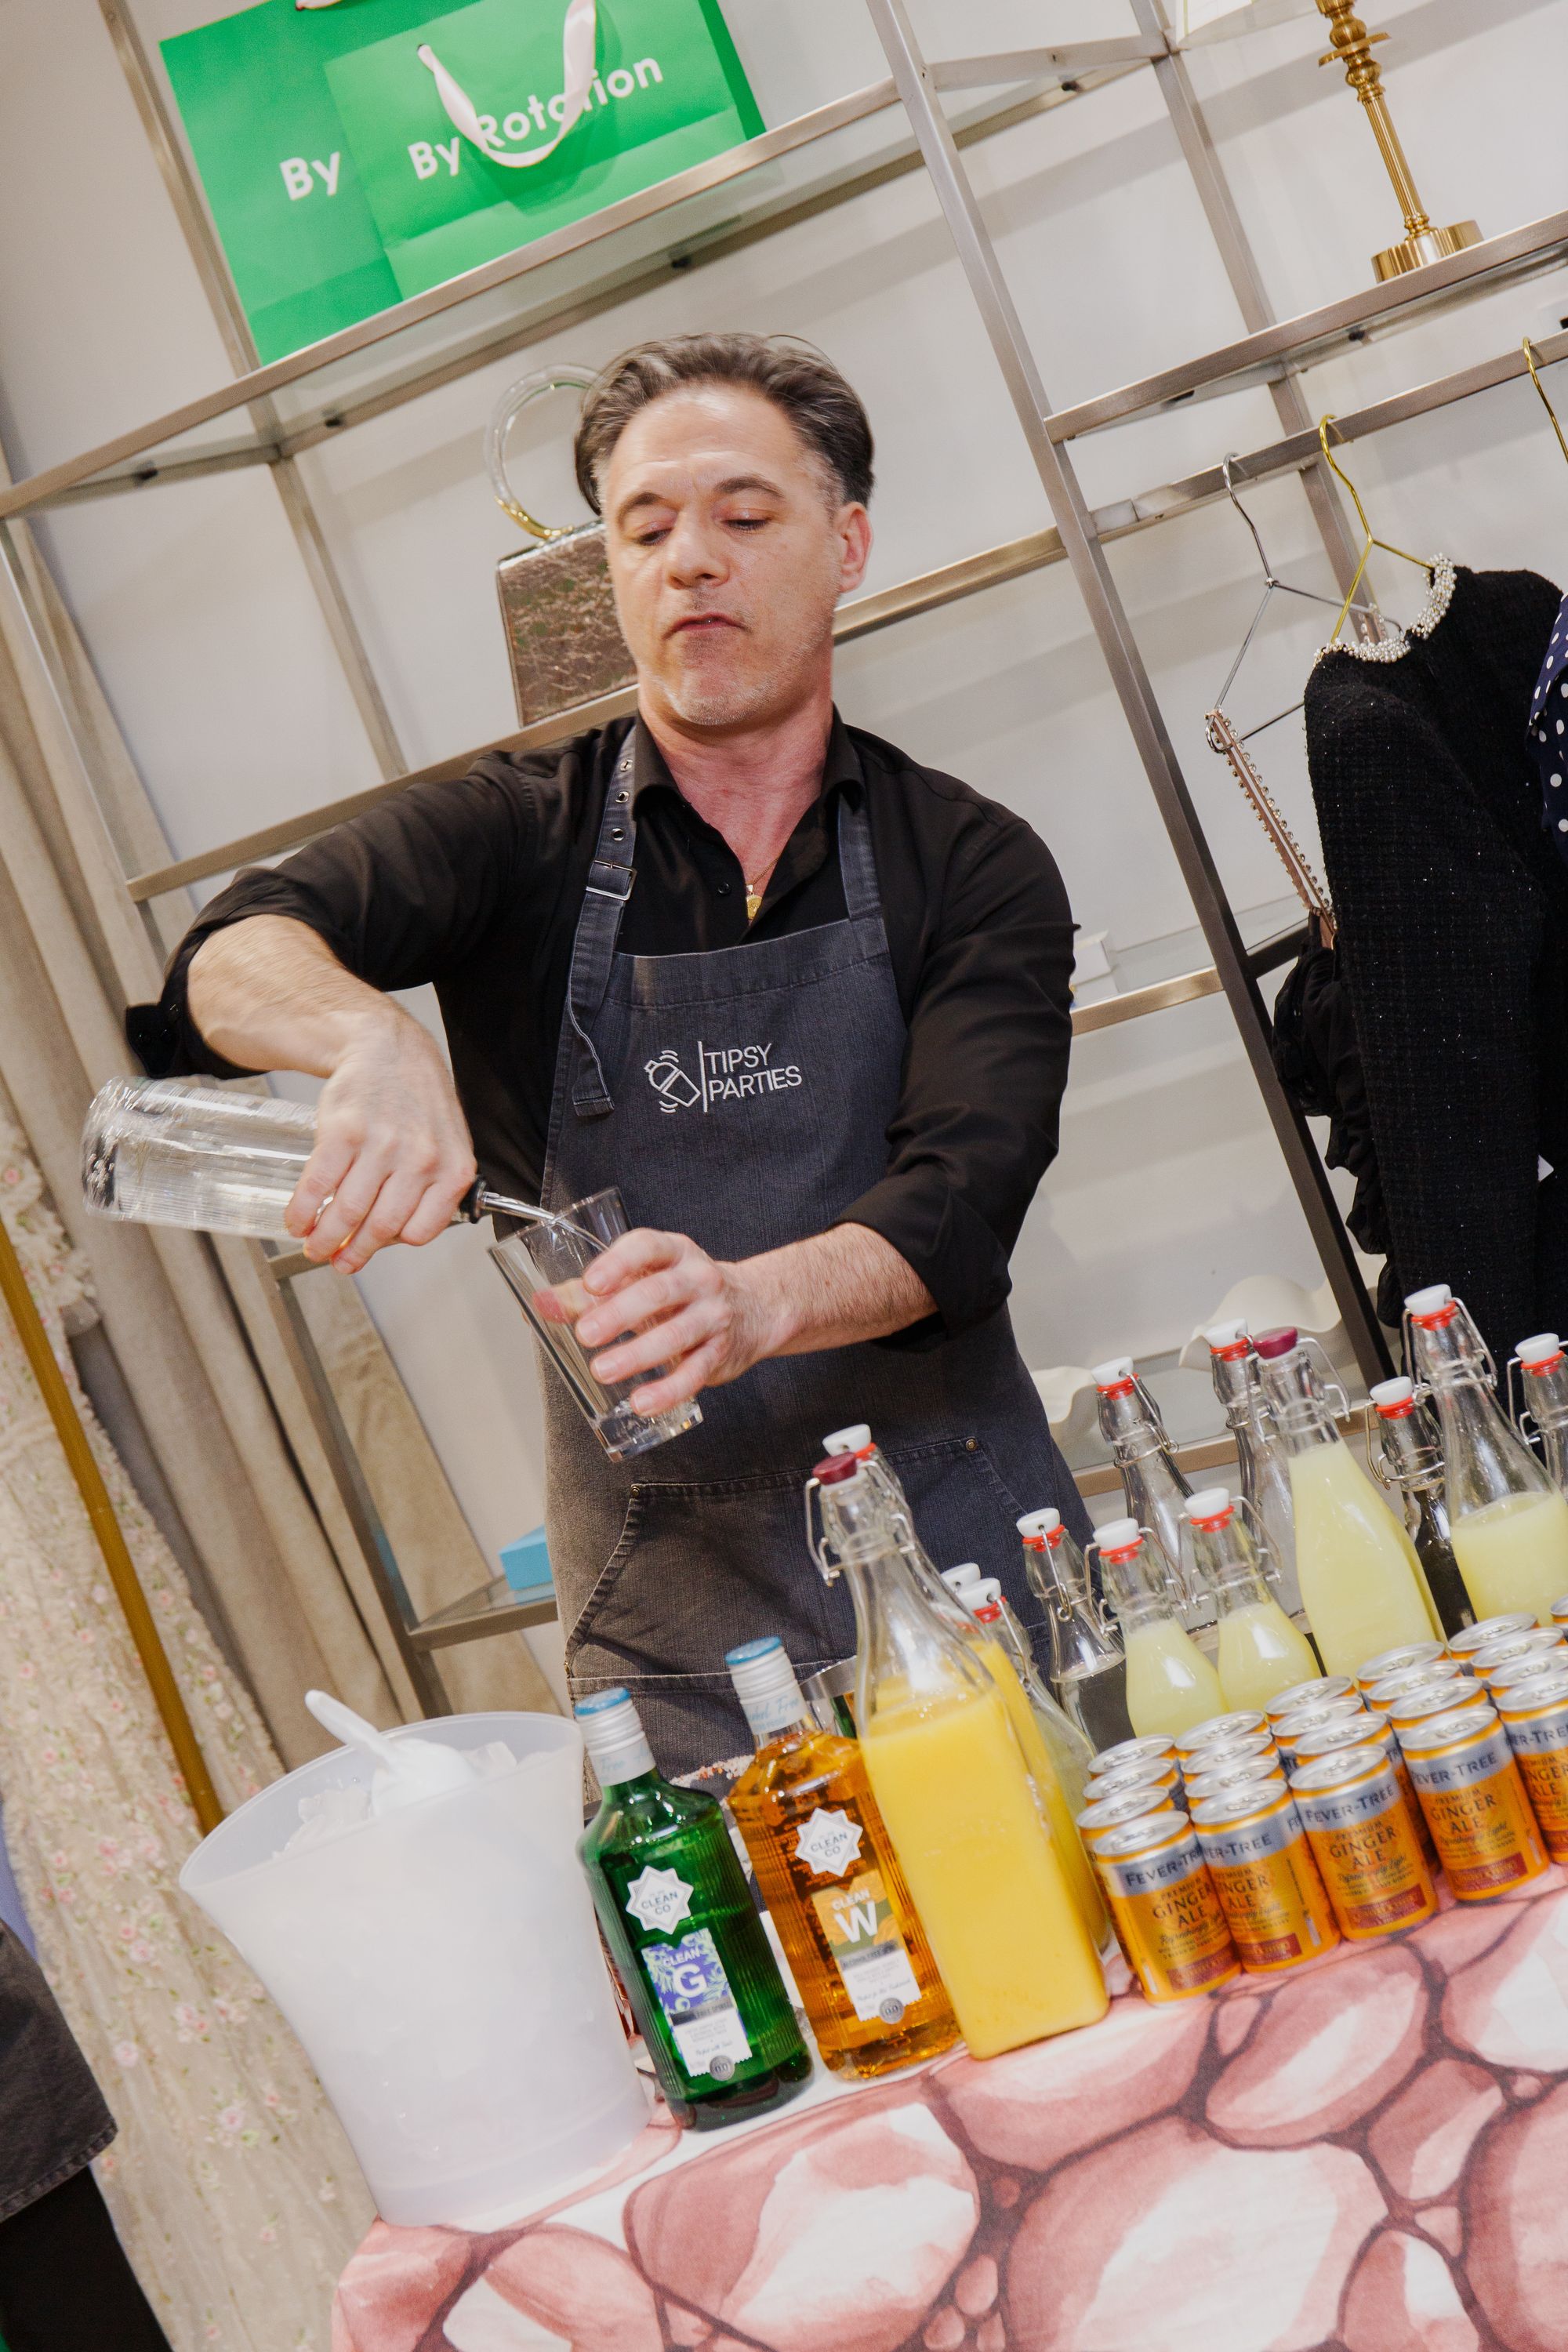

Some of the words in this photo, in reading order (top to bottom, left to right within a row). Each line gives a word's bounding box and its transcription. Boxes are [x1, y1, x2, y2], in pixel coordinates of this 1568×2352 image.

[408, 136, 459, 180] By
[279, 151, 340, 201] By
[704, 1043, 772, 1074] TIPSY
[709, 1065, 803, 1101] PARTIES
[1305, 1784, 1395, 1823] FEVER-TREE
[1430, 1794, 1497, 1820] GINGER
[1450, 1816, 1483, 1835] ALE
[810, 1831, 848, 1853] CLEAN
[825, 1846, 841, 1857] CO
[1330, 1825, 1397, 1858] GINGER
[1352, 1849, 1386, 1869] ALE
[641, 1892, 678, 1910] CLEAN
[655, 1904, 671, 1915] CO
[832, 1889, 871, 1911] CLEAN
[1228, 1893, 1256, 1910] ALE
[833, 1900, 878, 1944] W
[1178, 1905, 1207, 1929] ALE
[663, 1947, 702, 1966] CLEAN
[673, 1963, 707, 1998] G
